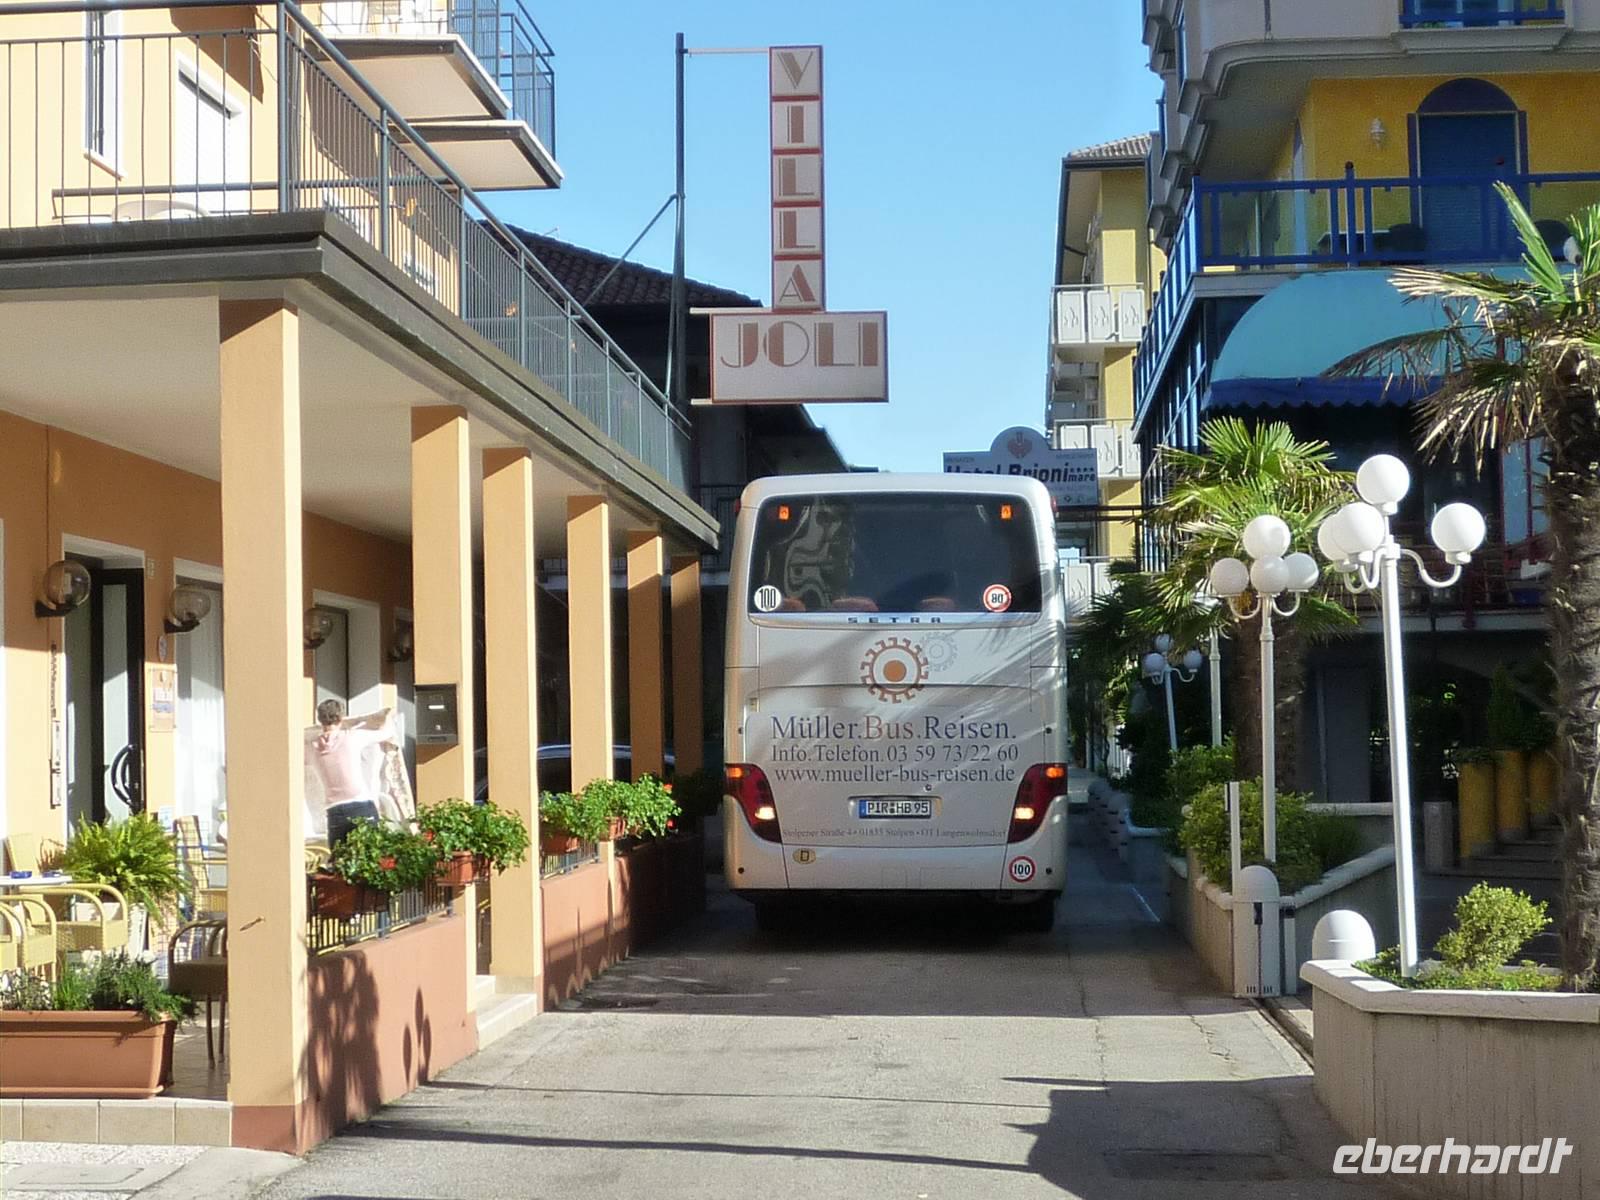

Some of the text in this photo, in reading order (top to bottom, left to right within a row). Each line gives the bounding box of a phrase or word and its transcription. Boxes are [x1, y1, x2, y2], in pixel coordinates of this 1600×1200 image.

[777, 51, 816, 302] VILLA
[720, 320, 879, 368] JOLI
[759, 588, 776, 609] 100
[991, 593, 1004, 604] 80
[848, 616, 941, 624] SETRA
[914, 744, 936, 762] 59
[943, 744, 991, 761] 73/22
[997, 743, 1019, 761] 60
[775, 764, 1015, 782] www.mueller-bus-reisen.de
[914, 802, 929, 814] 95
[1014, 864, 1031, 875] 100
